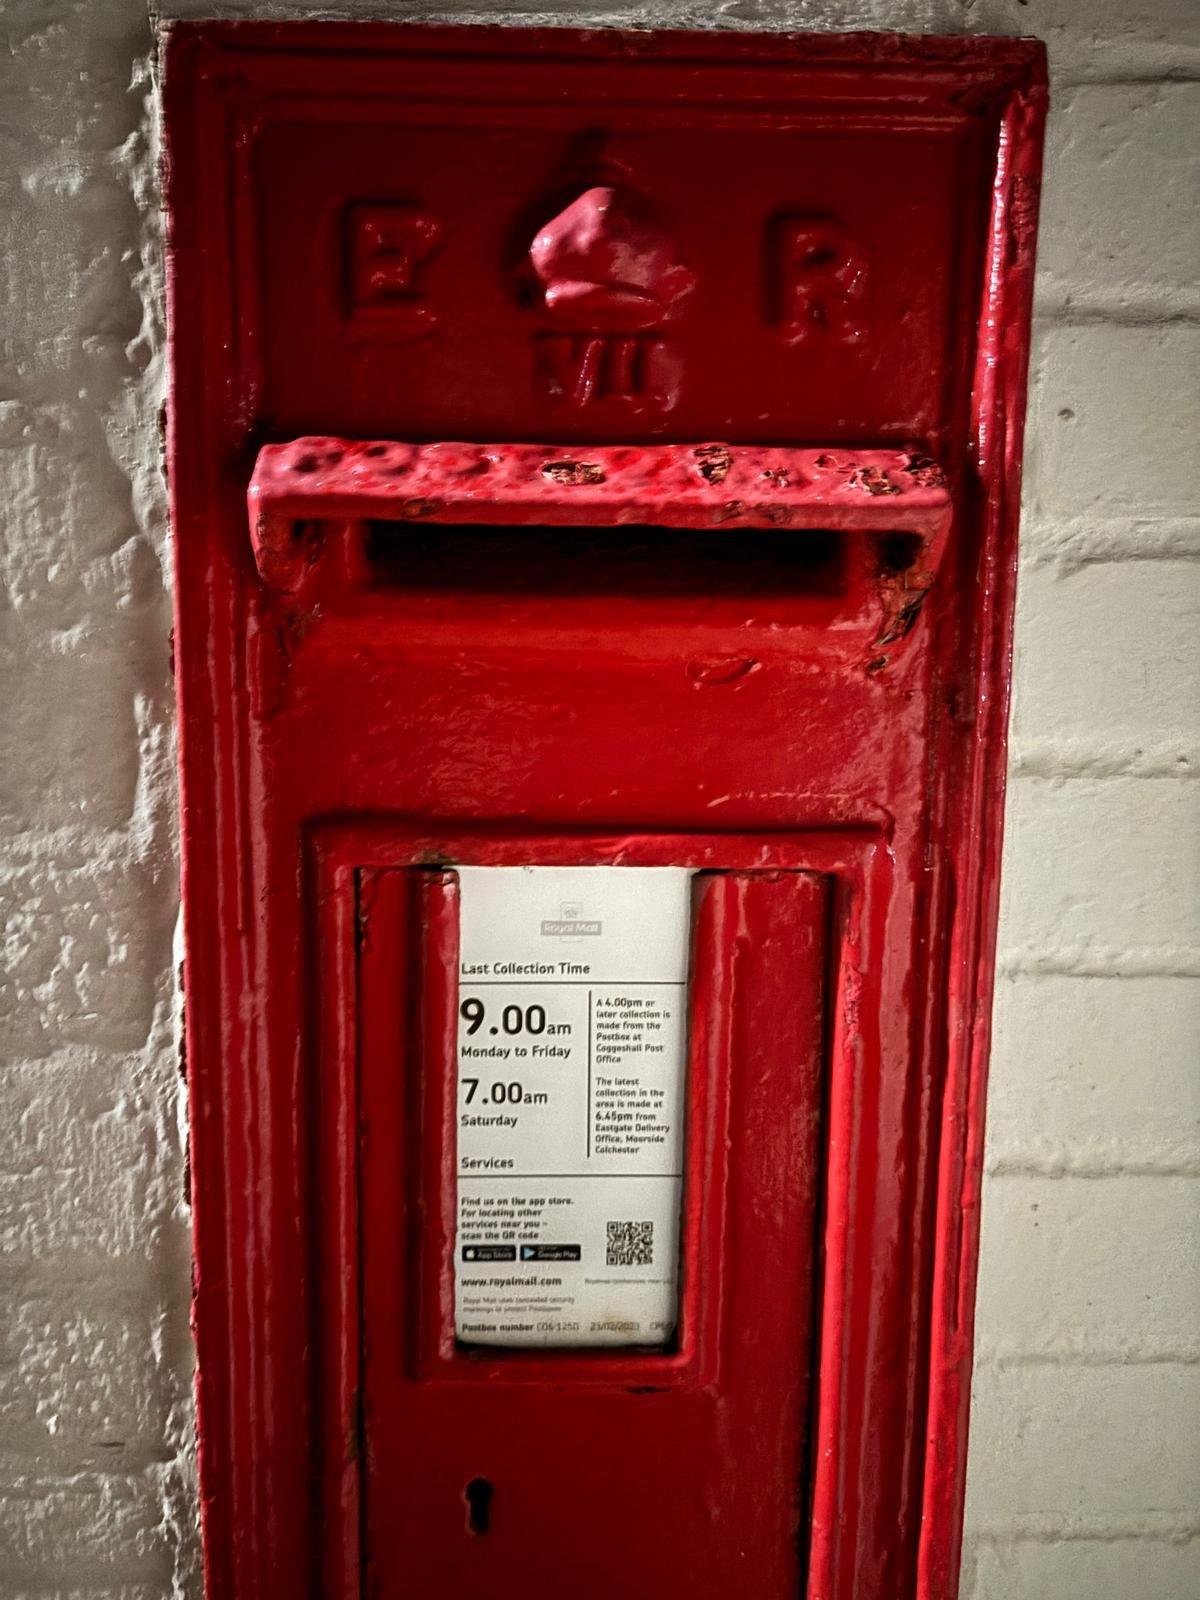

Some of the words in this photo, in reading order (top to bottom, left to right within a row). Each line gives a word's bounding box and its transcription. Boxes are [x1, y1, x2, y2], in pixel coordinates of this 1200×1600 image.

[336, 199, 440, 328] E
[767, 208, 868, 346] R
[461, 963, 489, 975] Last
[493, 963, 554, 975] Collection
[558, 962, 590, 974] Time
[596, 998, 602, 1007] A
[605, 997, 642, 1009] 4.00pm
[645, 1000, 656, 1008] or
[460, 997, 572, 1036] 9.00am
[596, 1010, 617, 1019] later
[619, 1010, 660, 1019] collection
[663, 1010, 671, 1019] is
[596, 1021, 620, 1030] made
[622, 1021, 644, 1030] from
[646, 1021, 661, 1030] the
[596, 1032, 630, 1041] Postbox
[632, 1033, 642, 1041] at
[461, 1046, 511, 1060] Monday
[515, 1046, 528, 1058] to
[532, 1045, 571, 1060] Friday
[596, 1043, 642, 1054] Coggeshall
[644, 1043, 664, 1053] Post
[596, 1054, 621, 1064] Office
[595, 1076, 612, 1086] The
[614, 1077, 640, 1086] latest
[461, 1078, 548, 1105] 7.00am
[595, 1088, 636, 1097] collection
[638, 1088, 647, 1097] in
[650, 1089, 665, 1097] the
[595, 1101, 615, 1109] area
[617, 1099, 625, 1108] is
[627, 1099, 651, 1108] made
[595, 1110, 633, 1122] 6.45pm
[635, 1112, 657, 1121] from
[461, 1115, 518, 1129] Saturday
[595, 1123, 633, 1133] Eastgate
[635, 1123, 670, 1133] Delivery
[626, 1134, 665, 1144] Moorside
[595, 1145, 640, 1154] Colchester
[461, 1157, 514, 1169] Services
[461, 1197, 480, 1206] Find
[483, 1198, 494, 1206] us
[497, 1198, 508, 1206] on
[511, 1197, 527, 1206] the
[528, 1198, 546, 1208] app
[461, 1208, 477, 1217] For
[478, 1208, 515, 1219] locating
[517, 1208, 542, 1217] other
[461, 1220, 498, 1229] services
[500, 1220, 521, 1229] near
[523, 1221, 541, 1230] you
[461, 1231, 482, 1240] scan
[484, 1231, 500, 1240] the
[502, 1230, 516, 1240] QR
[518, 1230, 539, 1240] code
[461, 1275, 562, 1288] www.royalmail.com
[462, 1323, 497, 1332] Postbox
[499, 1323, 534, 1332] number
